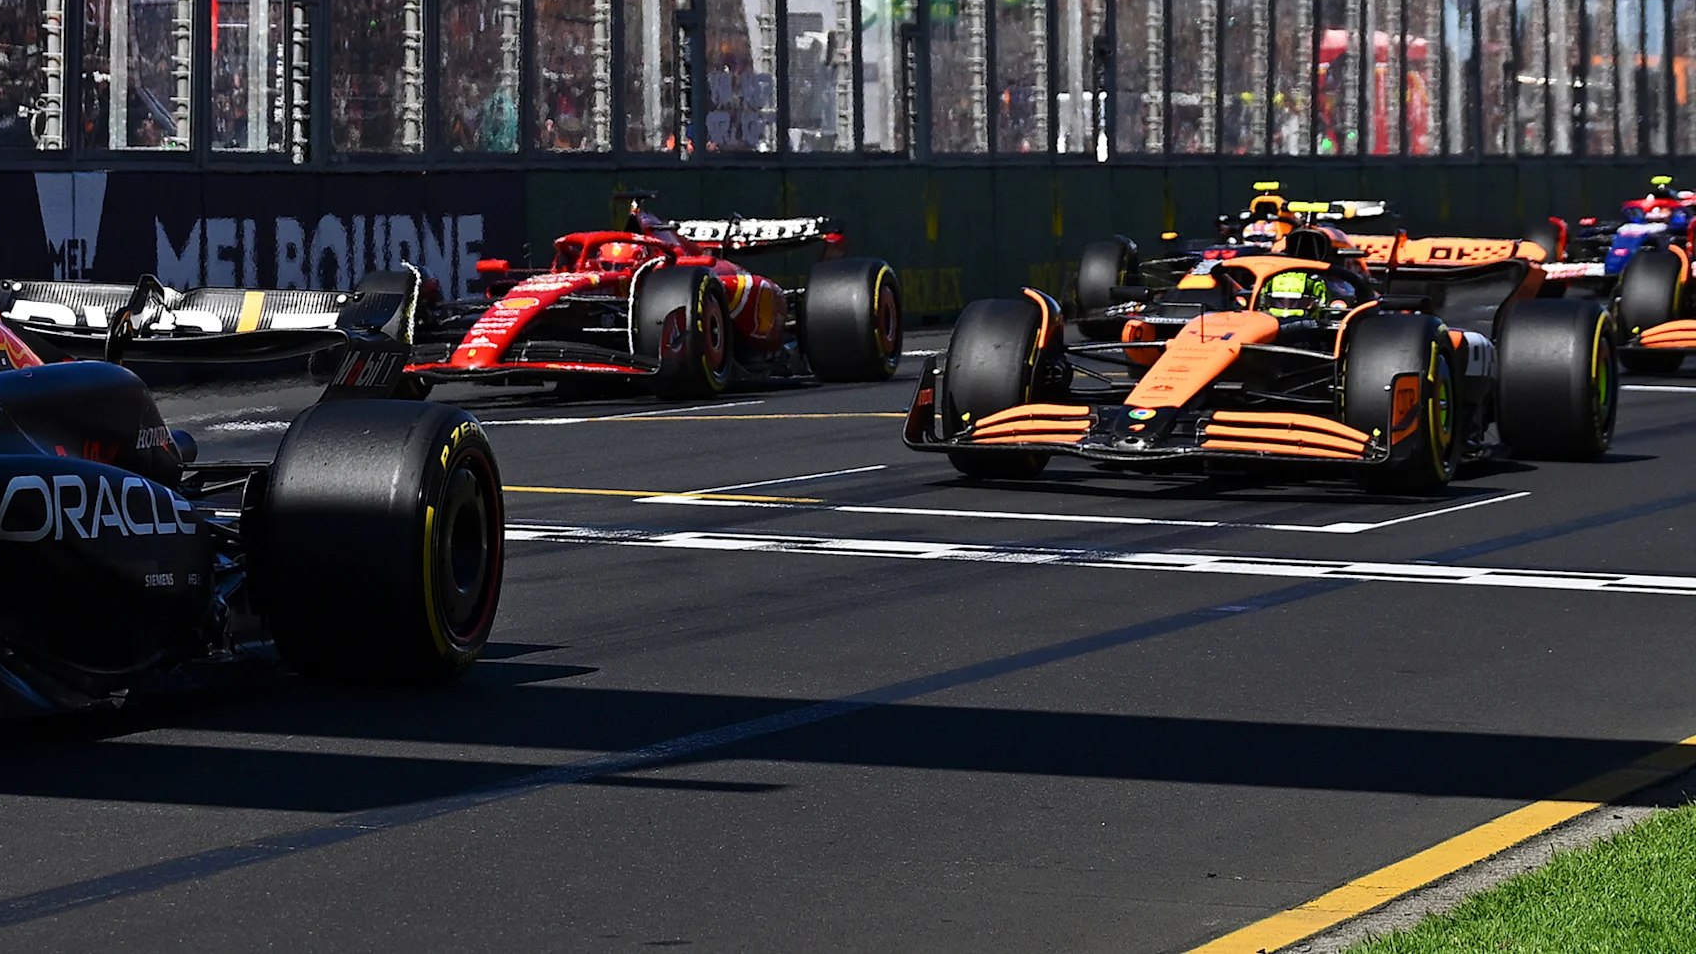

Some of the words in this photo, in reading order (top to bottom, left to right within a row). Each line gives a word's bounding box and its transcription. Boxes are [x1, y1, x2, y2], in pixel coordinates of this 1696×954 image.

[48, 239, 93, 282] MEL
[332, 351, 388, 387] Mobil
[136, 426, 173, 450] HONDA
[440, 445, 450, 470] P
[145, 573, 174, 587] SIEMENS
